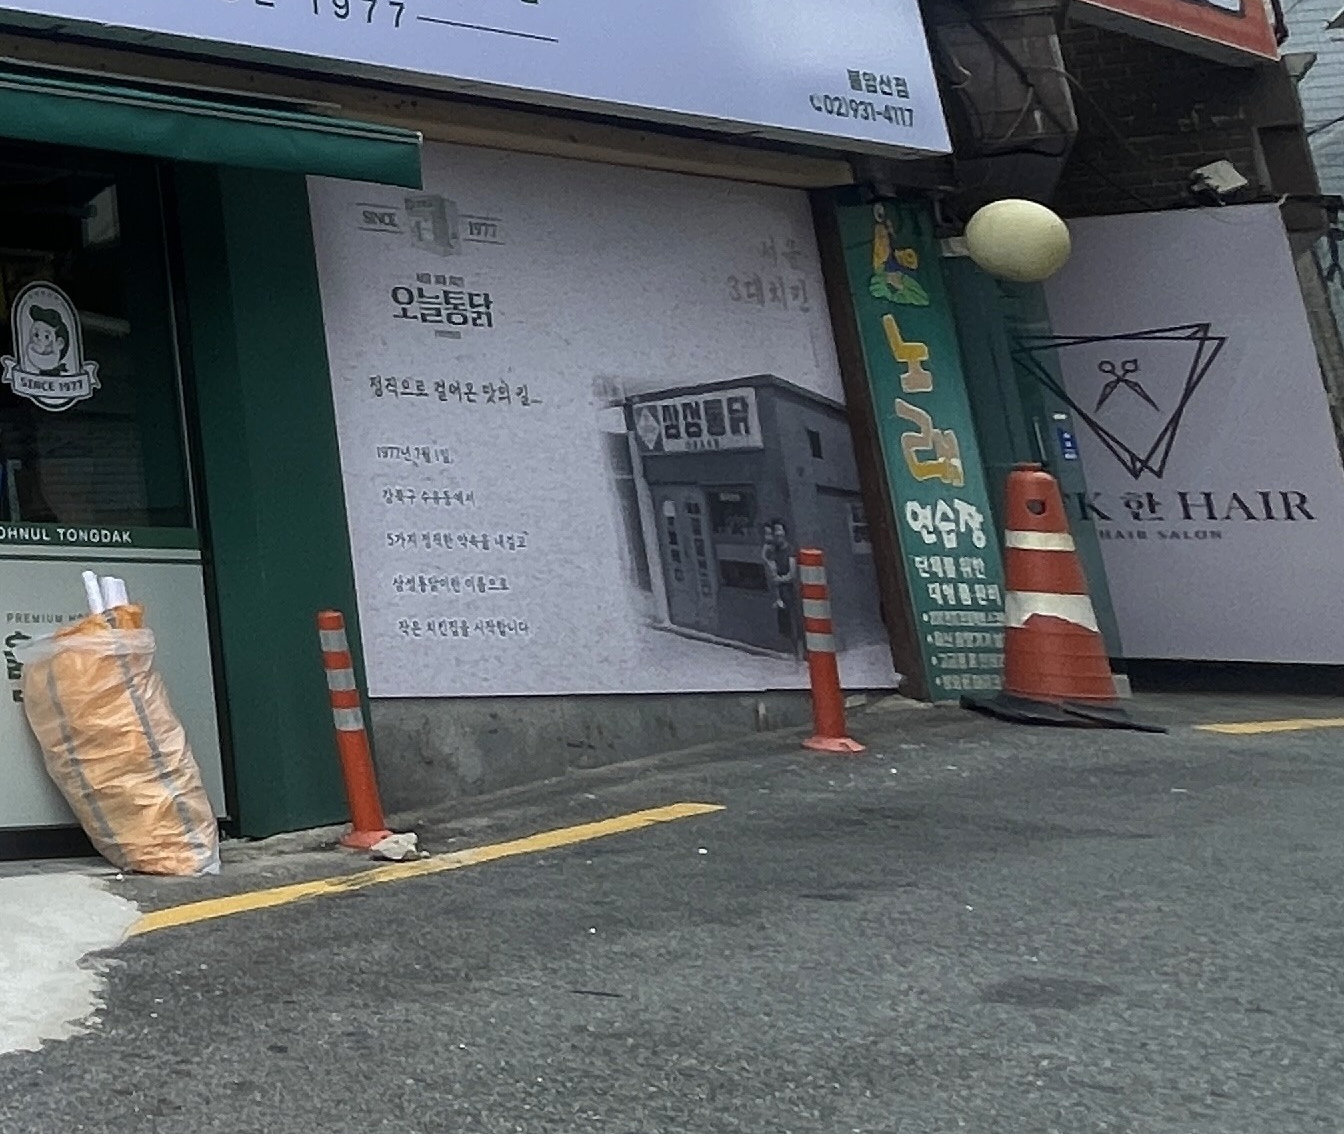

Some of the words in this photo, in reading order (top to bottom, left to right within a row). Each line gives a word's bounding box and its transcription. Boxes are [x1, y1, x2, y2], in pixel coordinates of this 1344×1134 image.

[391, 286, 494, 328] 오늘통닭
[1119, 491, 1165, 522] 한
[1177, 490, 1317, 522] HAIR
[57, 528, 132, 543] TONGDAK
